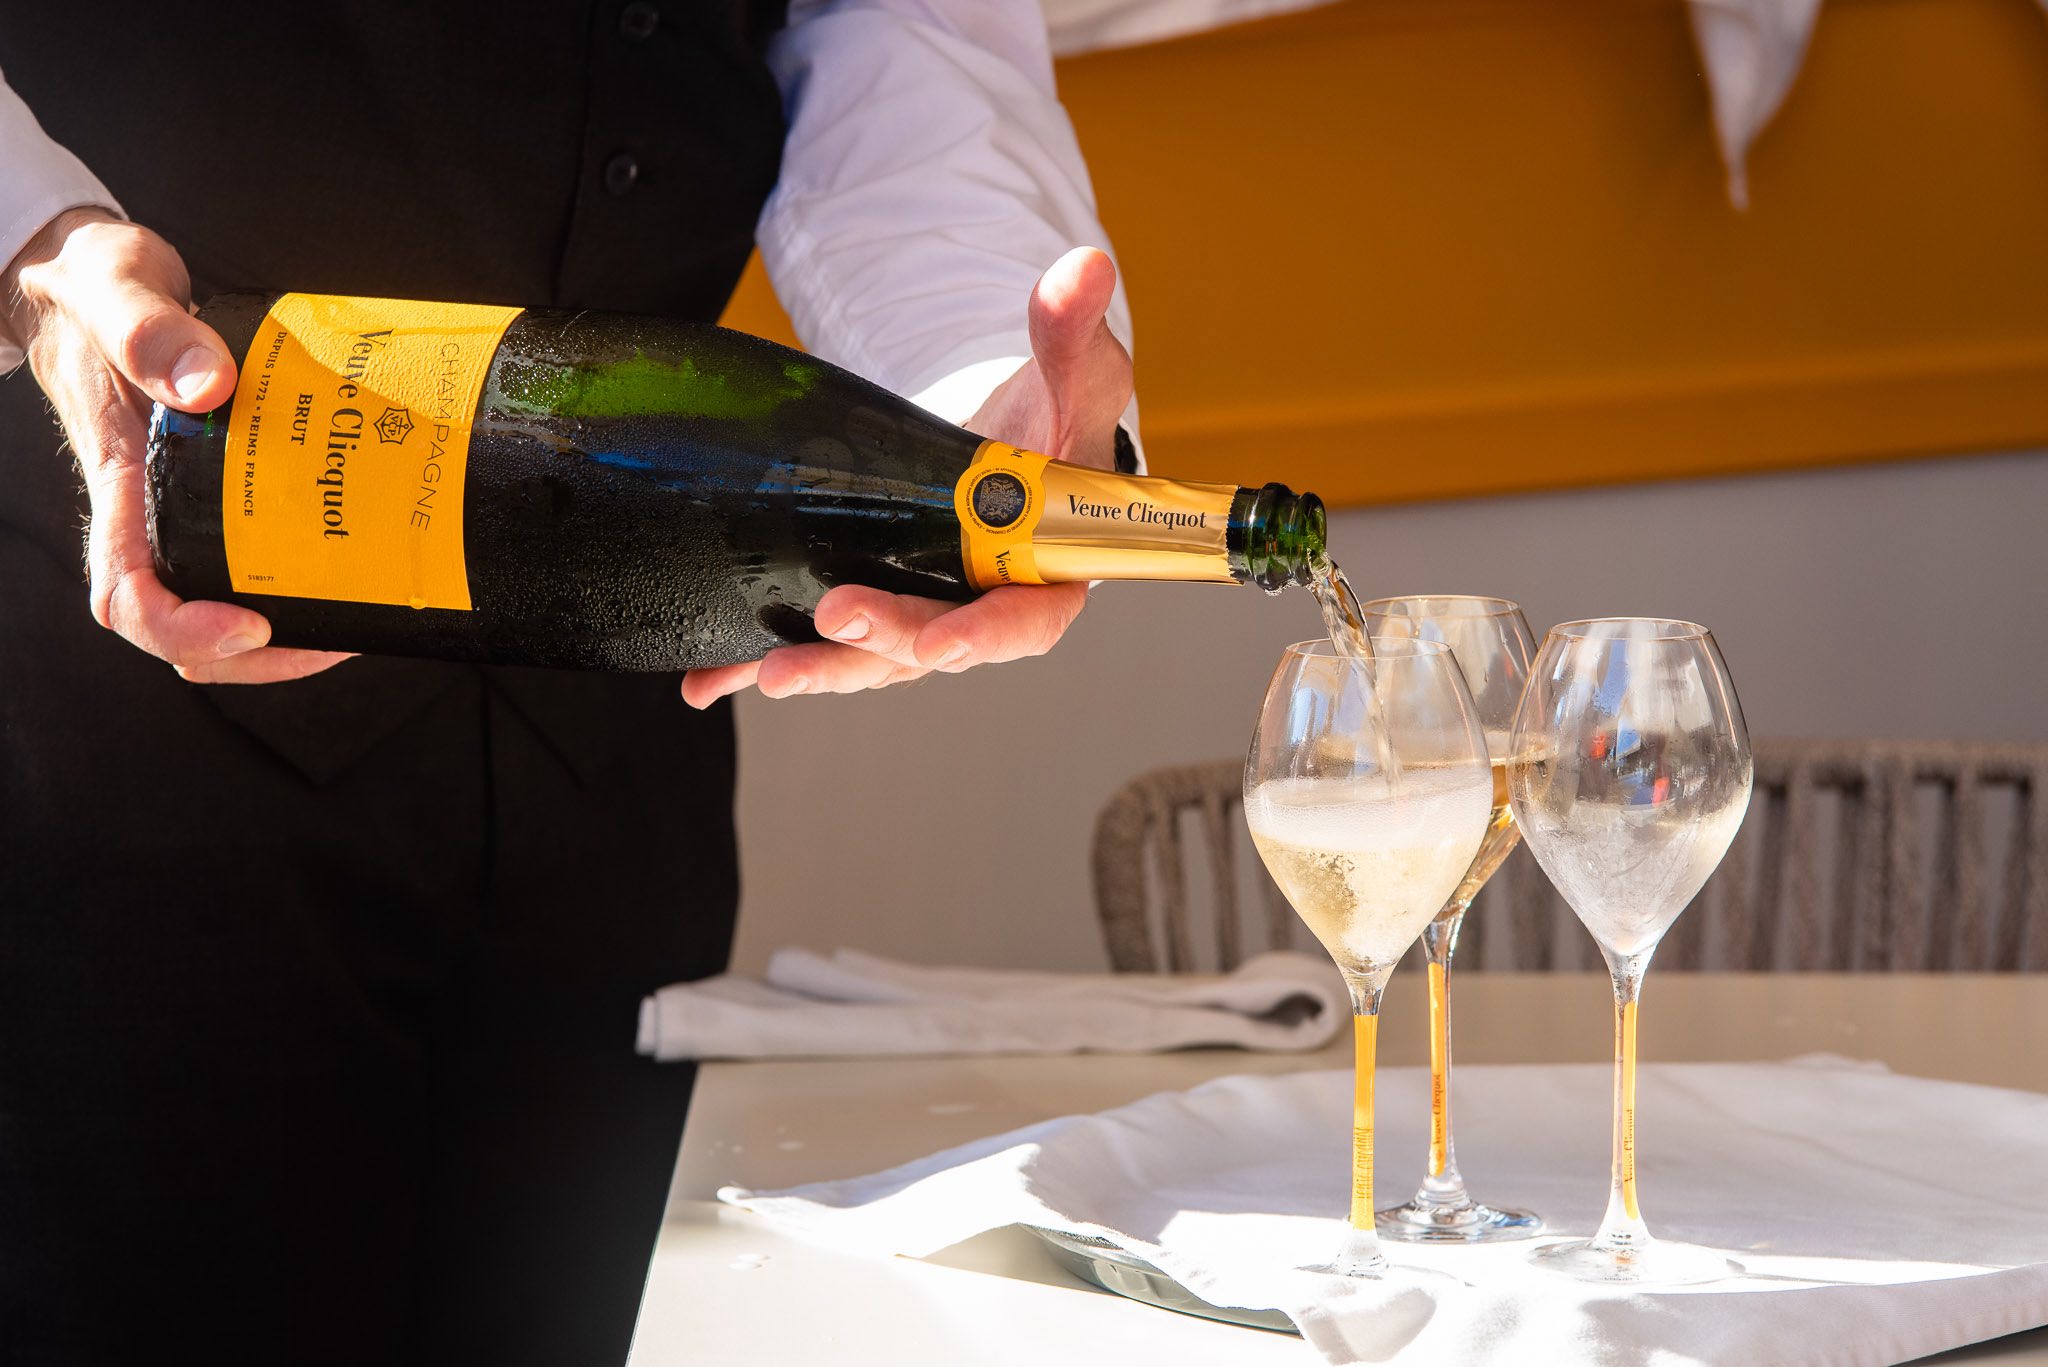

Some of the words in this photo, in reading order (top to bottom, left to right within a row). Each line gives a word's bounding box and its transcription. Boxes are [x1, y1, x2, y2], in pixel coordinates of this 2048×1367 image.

[266, 331, 287, 370] DEPUIS
[336, 328, 394, 399] Veuve
[253, 373, 271, 402] 1772
[246, 414, 261, 457] REIMS
[290, 392, 314, 445] BRUT
[410, 342, 460, 531] CHAMPAGNE
[243, 462, 255, 517] FRANCE
[316, 407, 364, 540] Clicquot
[1067, 494, 1121, 520] Veuve
[1127, 501, 1207, 530] Clicquot
[995, 549, 1011, 583] Veuve
